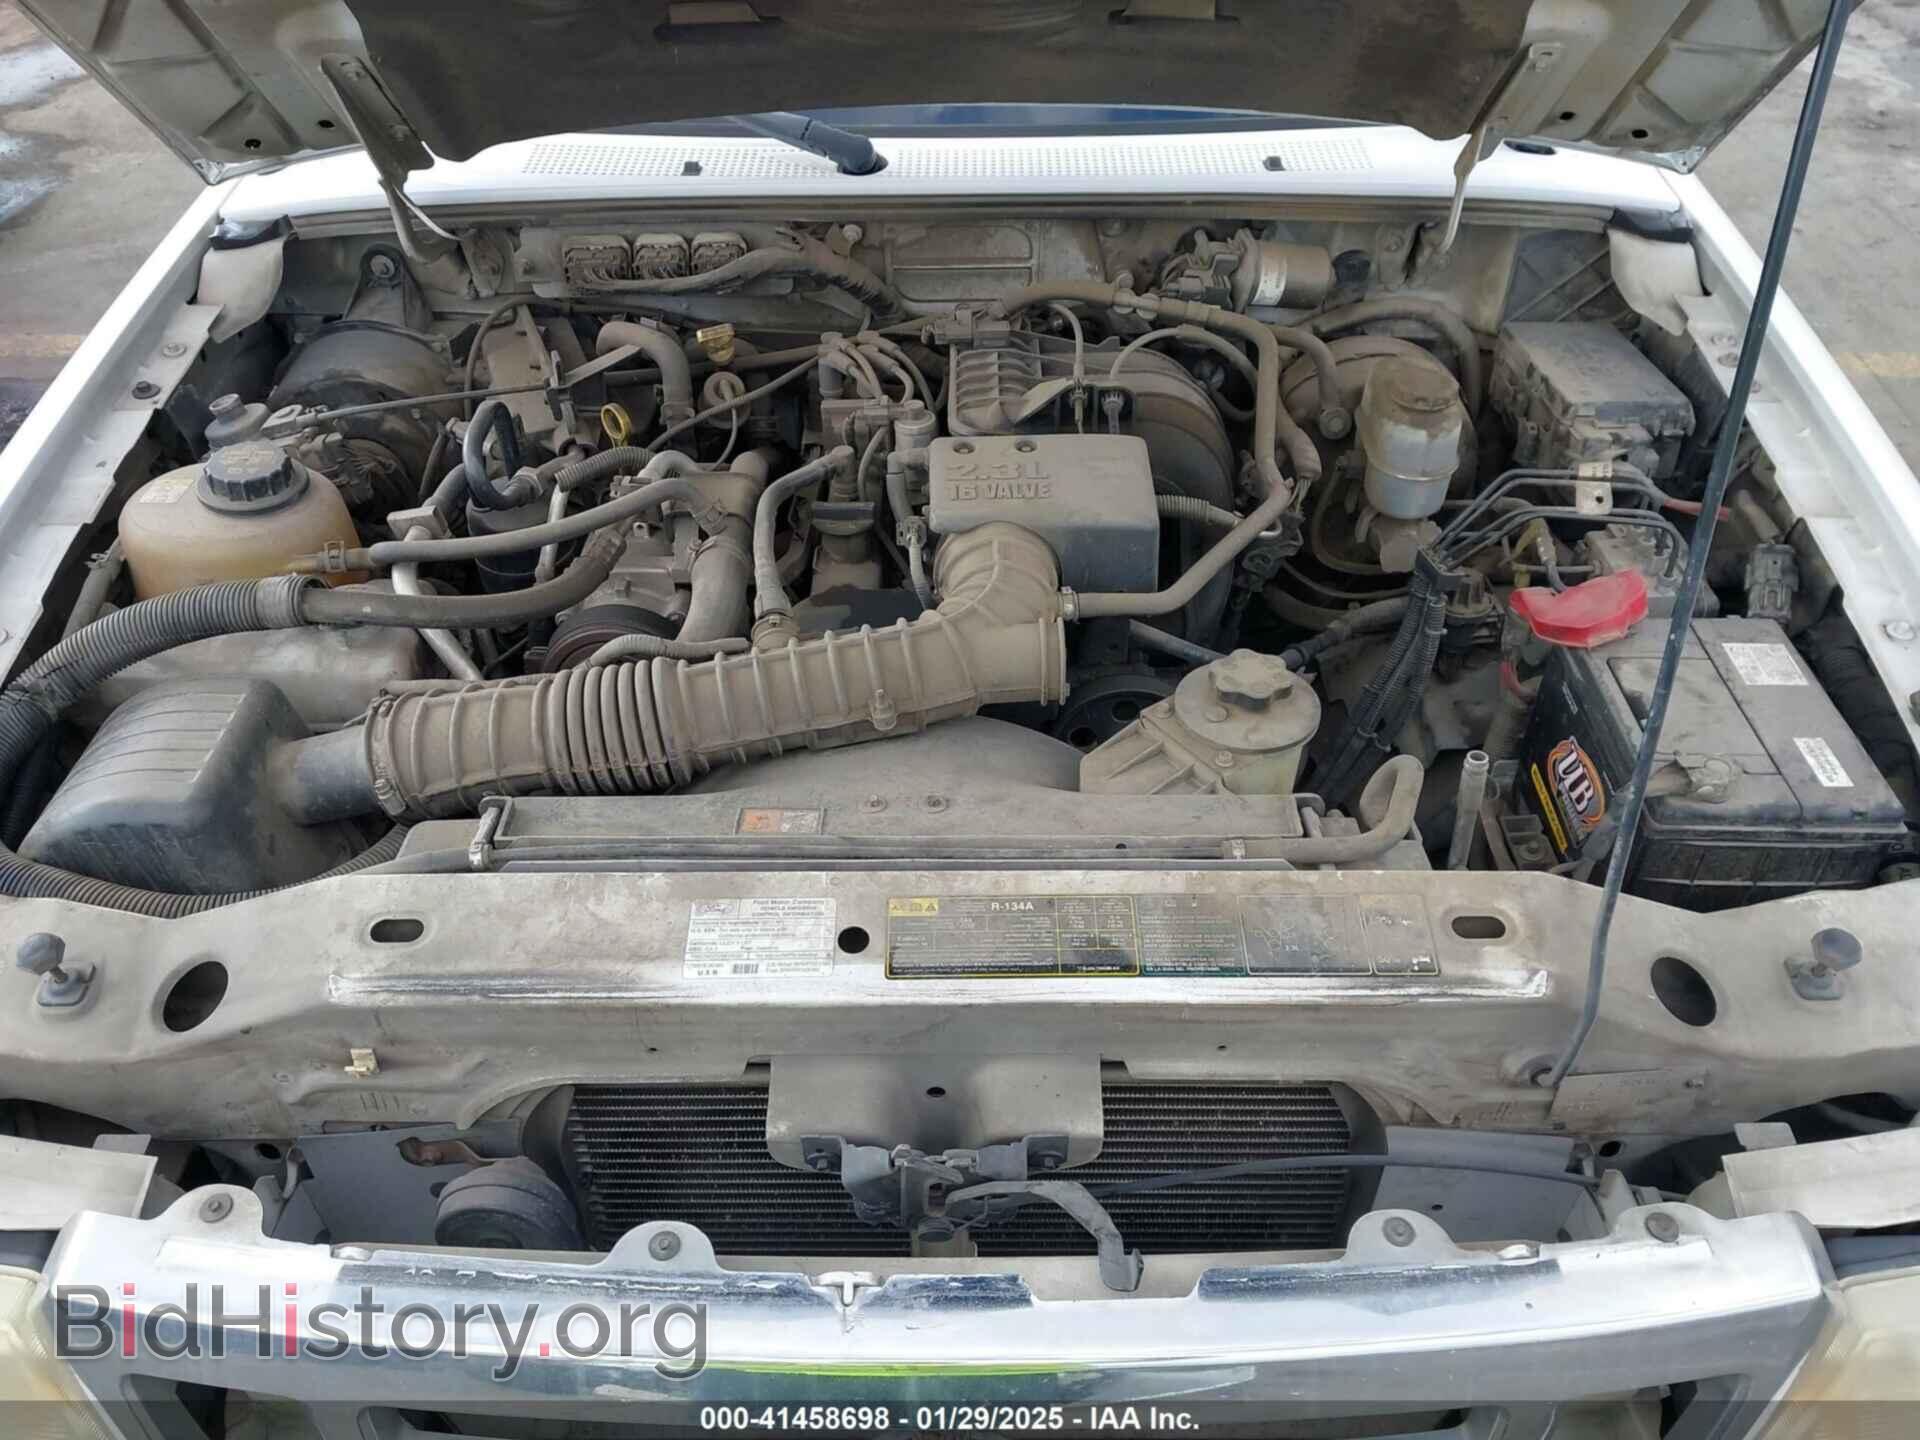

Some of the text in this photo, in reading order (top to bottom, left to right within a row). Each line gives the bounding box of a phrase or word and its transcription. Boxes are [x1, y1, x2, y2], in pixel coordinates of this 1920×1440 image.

[946, 461, 1049, 481] 2.3L
[948, 482, 1051, 501] 16 VALVE
[990, 902, 1034, 912] R-134A
